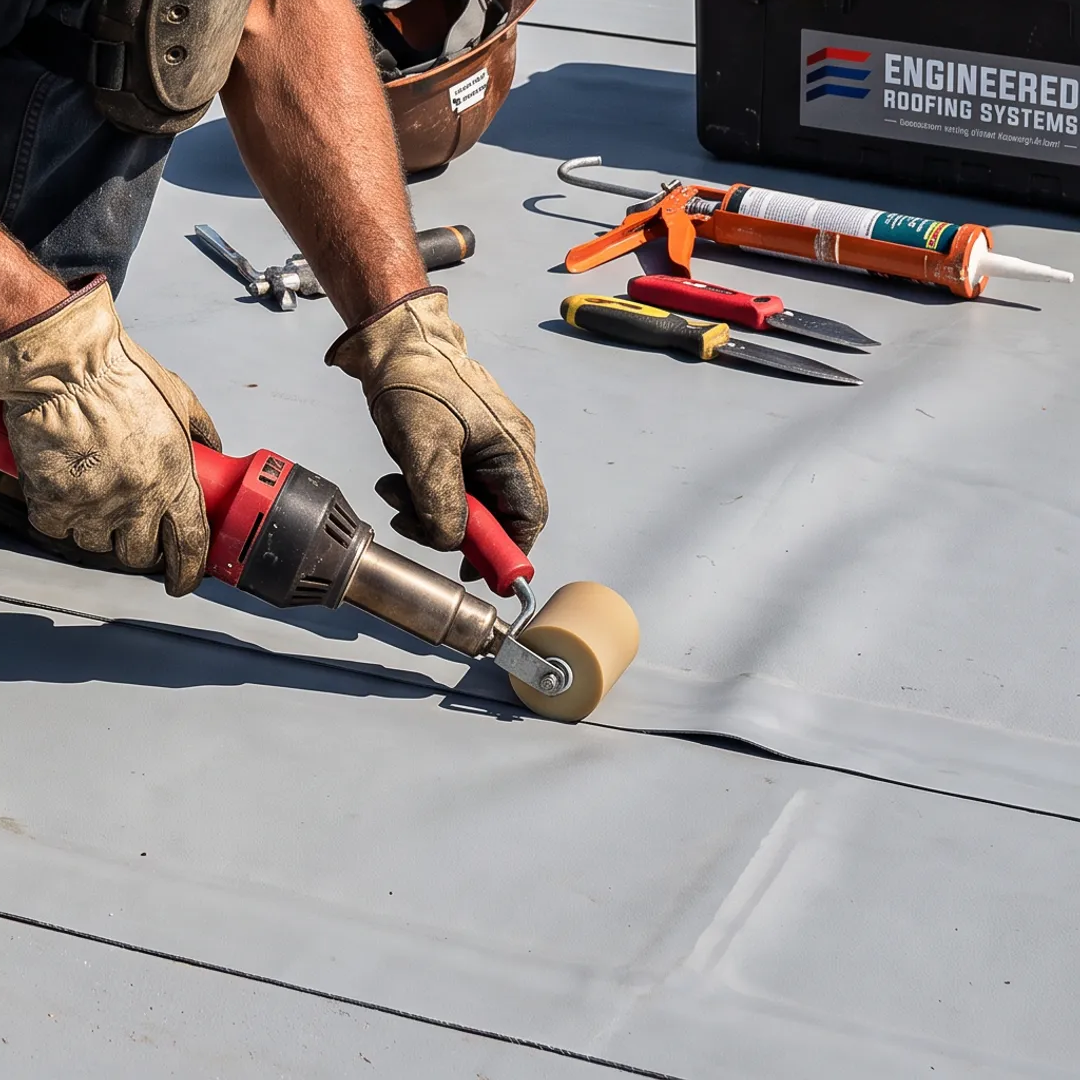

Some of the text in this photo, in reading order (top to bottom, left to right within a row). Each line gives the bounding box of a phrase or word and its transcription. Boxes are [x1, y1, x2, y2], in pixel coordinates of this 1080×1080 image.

[884, 53, 1079, 110] ENGINEERED
[883, 89, 972, 120] ROOFING
[980, 102, 1078, 135] SYSTEMS
